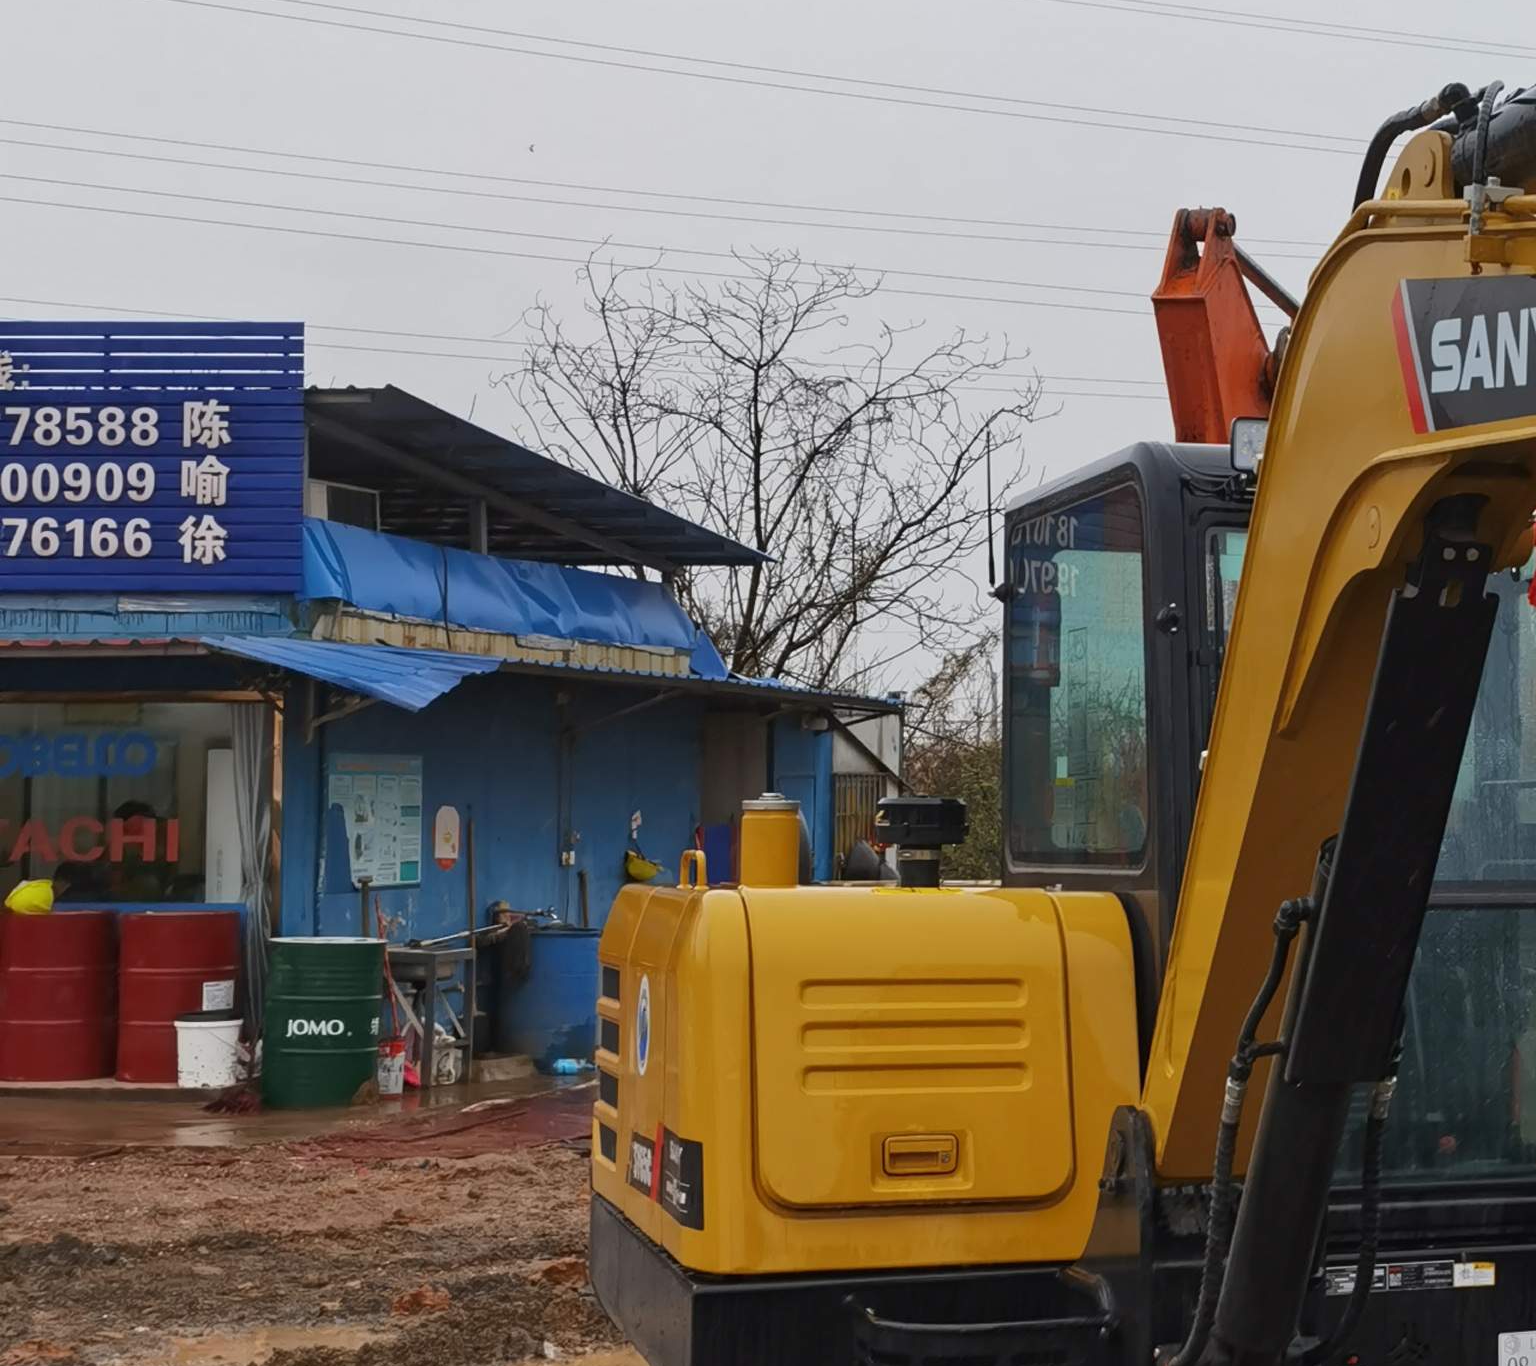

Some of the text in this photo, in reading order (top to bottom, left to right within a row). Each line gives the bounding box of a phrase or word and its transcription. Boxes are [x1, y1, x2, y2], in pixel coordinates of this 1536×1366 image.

[4, 399, 232, 449] 78588 陈
[0, 455, 231, 506] 00909 喻
[1, 514, 228, 565] 76166 徐
[0, 815, 181, 862] ACHI
[286, 1019, 345, 1038] JOMO
